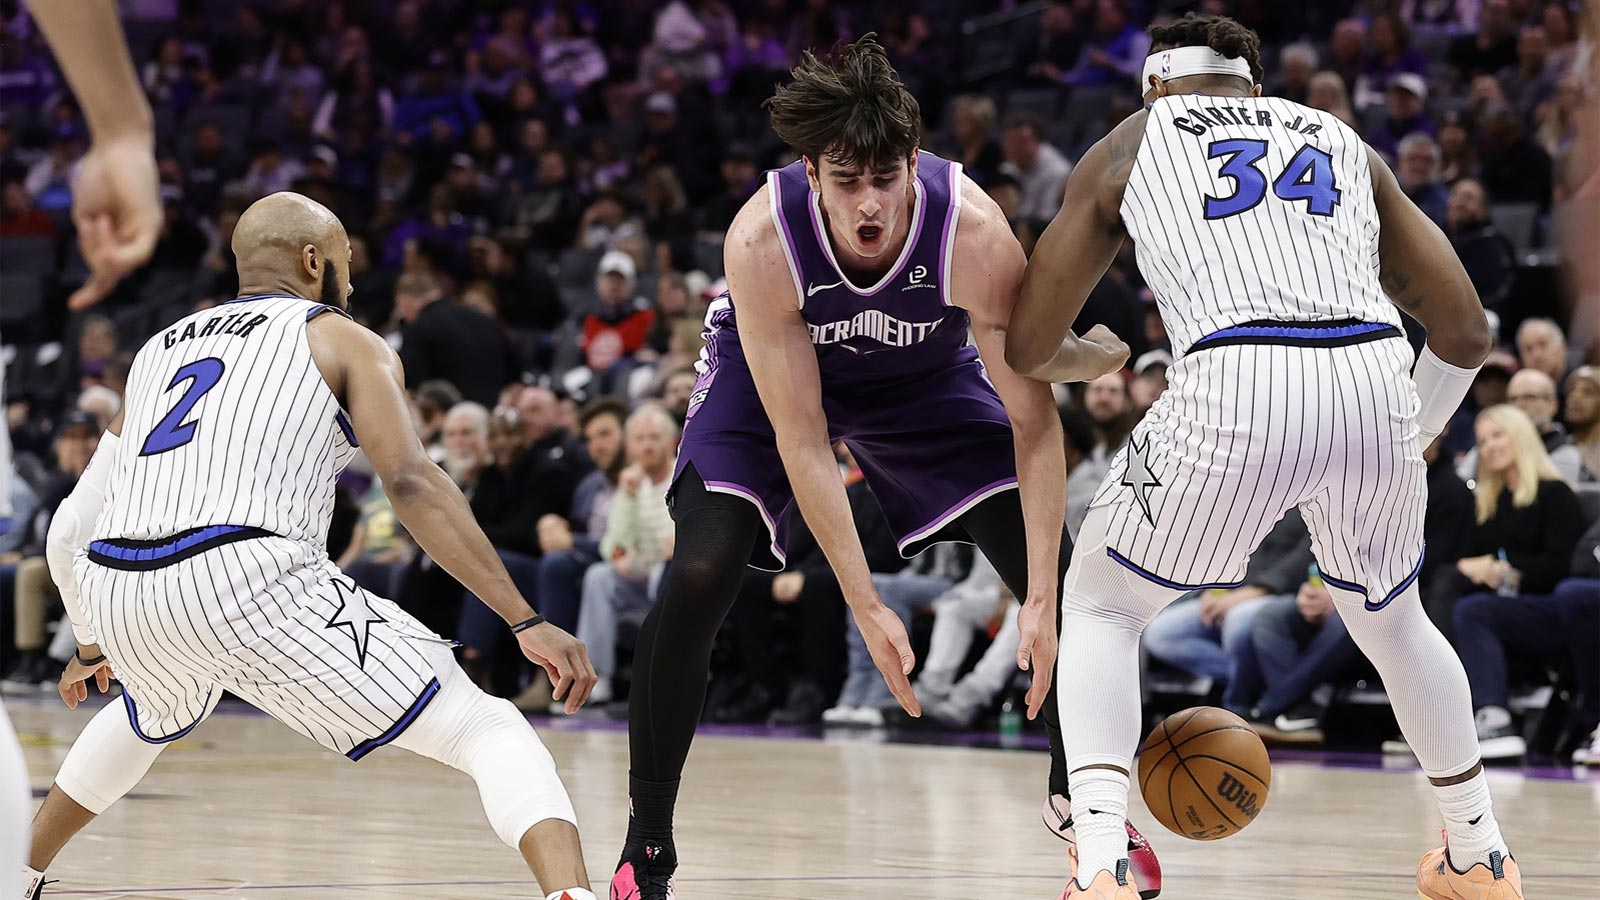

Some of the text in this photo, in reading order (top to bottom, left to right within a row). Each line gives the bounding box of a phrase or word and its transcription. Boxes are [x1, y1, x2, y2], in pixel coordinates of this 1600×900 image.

[1173, 106, 1272, 136] CARTER
[1203, 138, 1341, 220] 34
[164, 312, 268, 350] CARTER
[806, 309, 945, 347] ACRAMENT
[138, 357, 226, 457] 2
